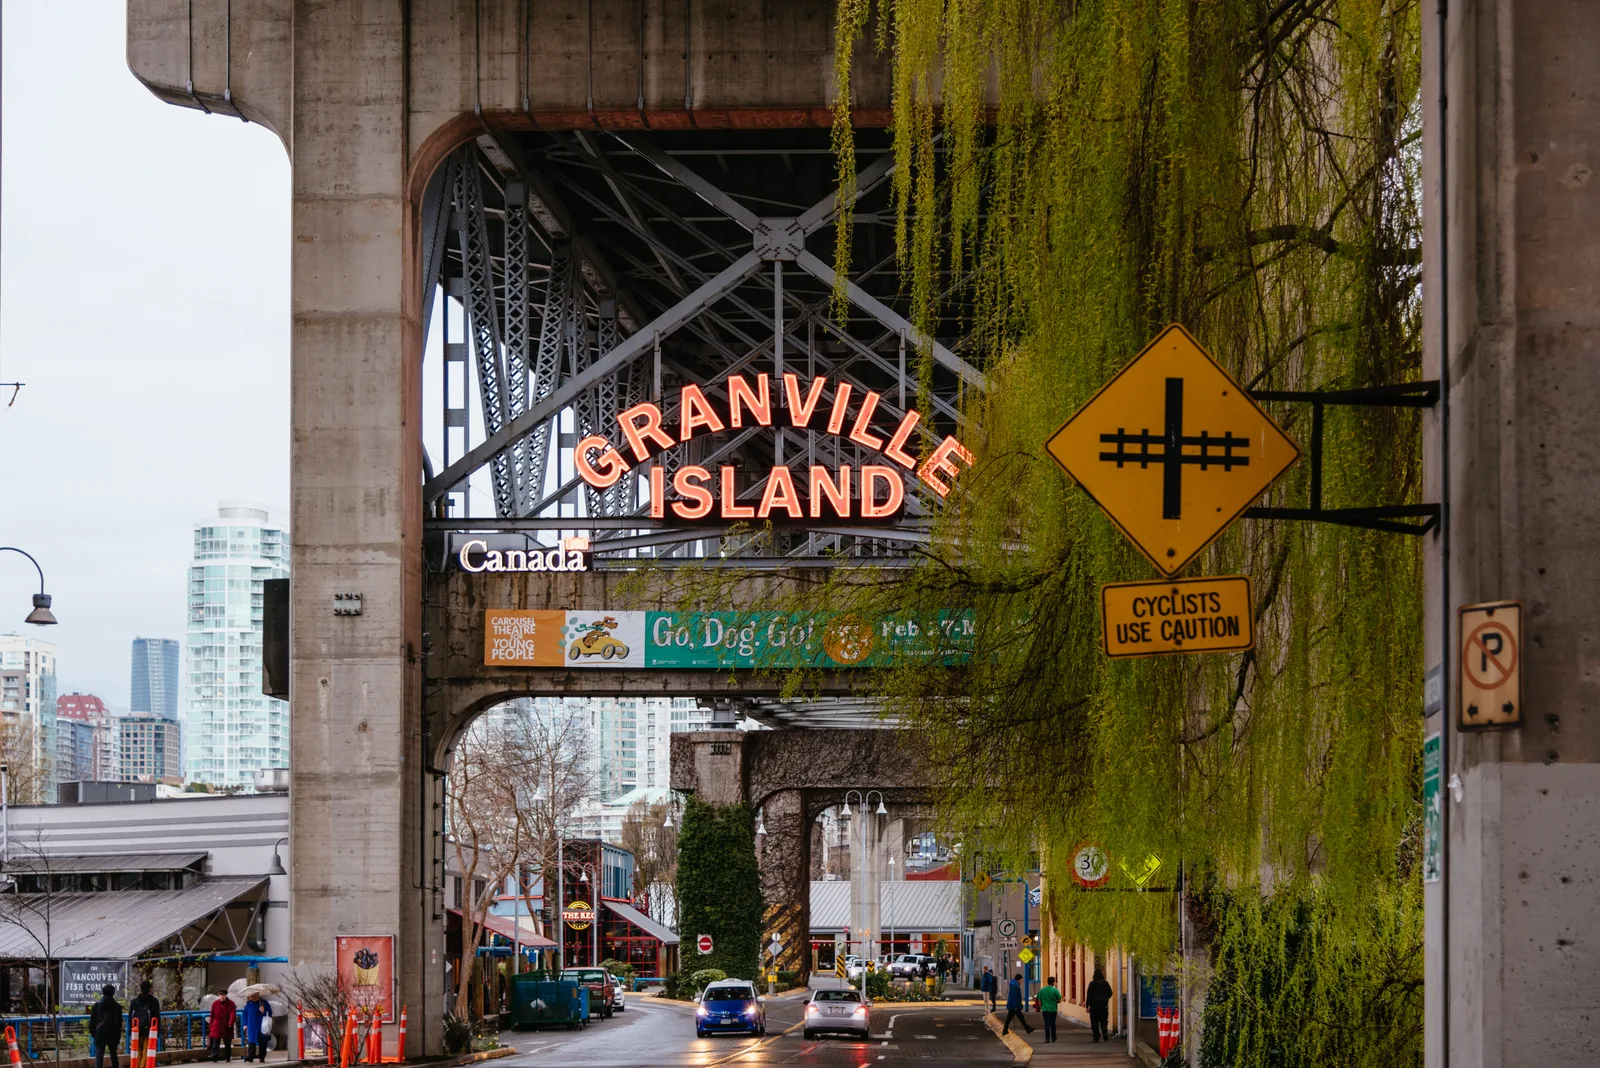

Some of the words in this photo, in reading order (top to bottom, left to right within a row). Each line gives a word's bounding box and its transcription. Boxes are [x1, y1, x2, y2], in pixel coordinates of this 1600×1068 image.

[574, 373, 976, 497] GRANVILLE
[651, 465, 904, 519] ISLAND
[459, 540, 587, 573] Canada
[1132, 592, 1221, 618] CYCLISTS
[491, 616, 537, 627] CAROUSEL
[493, 625, 536, 635] THEATRE
[881, 619, 920, 637] Feb
[1116, 621, 1152, 644] USE
[1160, 616, 1240, 641] CAUTION
[493, 638, 535, 649] YOUNG
[652, 616, 694, 650] Go,
[702, 617, 760, 656] Dog.
[767, 616, 815, 650] Go!
[491, 648, 535, 660] PEOPLE
[72, 973, 118, 981] VANCOUVER
[65, 983, 83, 991] FISH
[86, 983, 121, 991] COMPY
